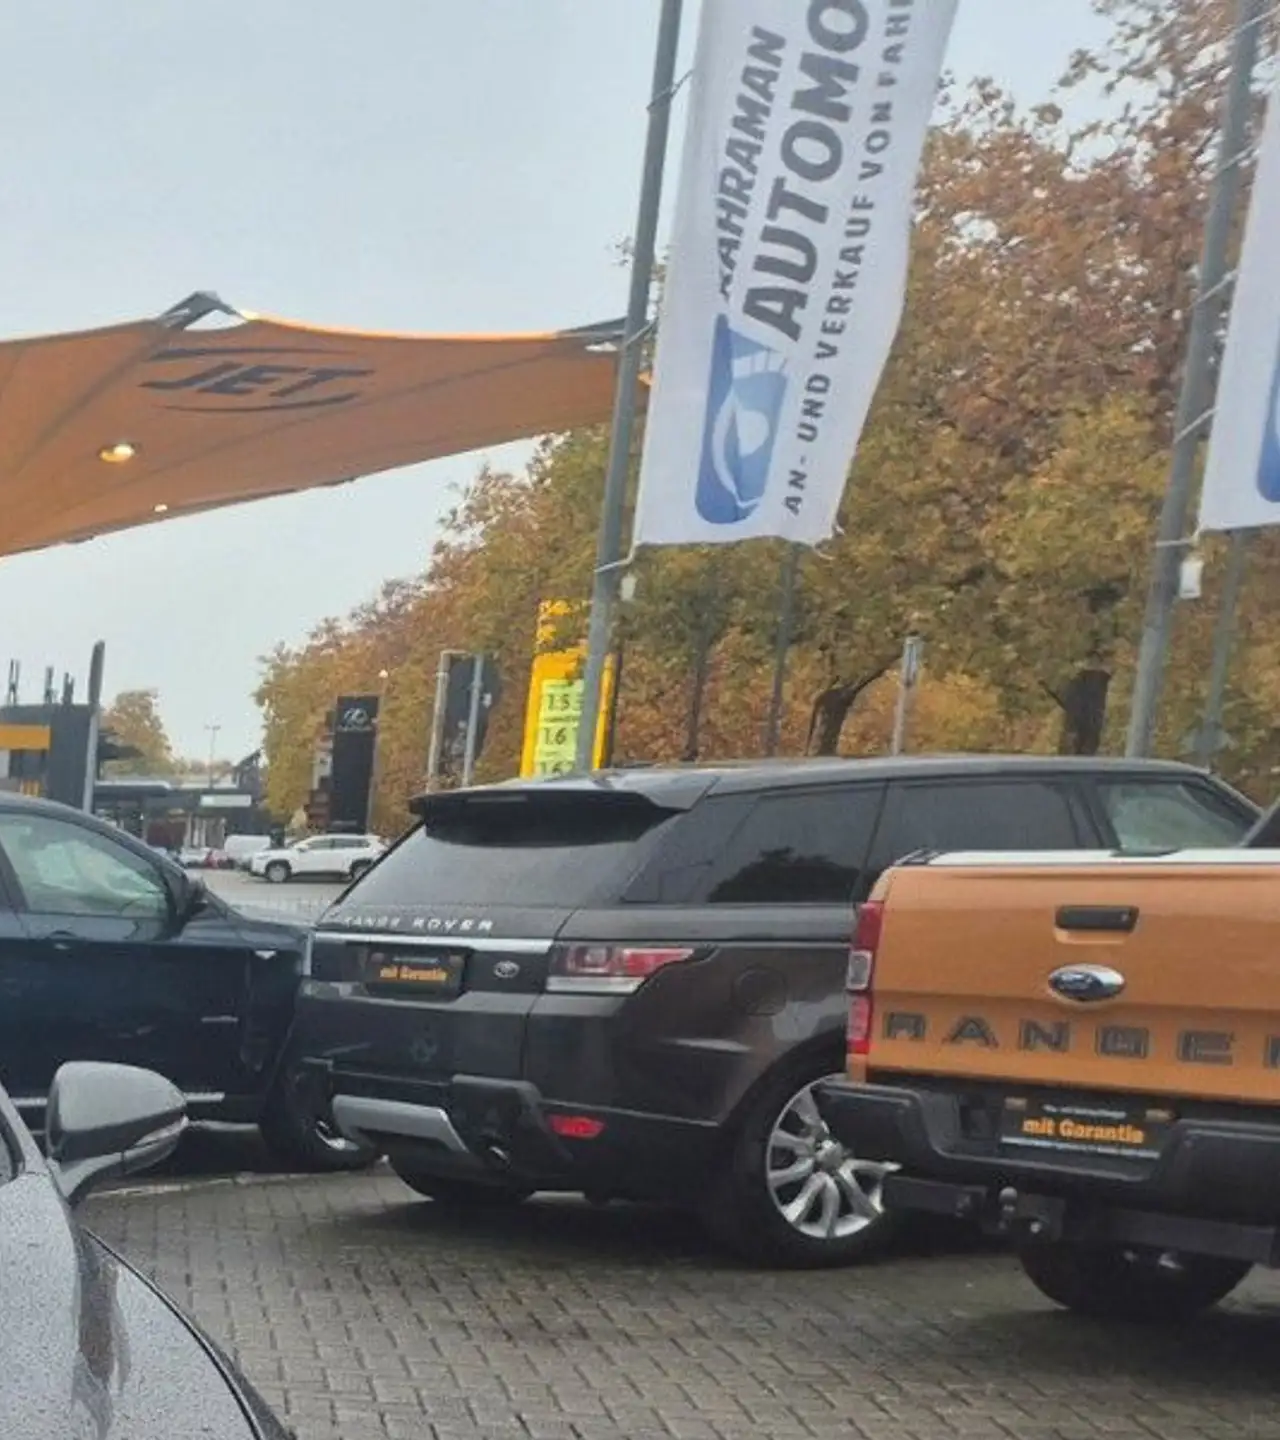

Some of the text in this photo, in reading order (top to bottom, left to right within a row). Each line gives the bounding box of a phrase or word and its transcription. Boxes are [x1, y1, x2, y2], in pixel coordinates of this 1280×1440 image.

[742, 0, 870, 342] AUTOMO
[797, 374, 831, 442] UND
[814, 196, 875, 361] VERKAUF
[858, 102, 892, 181] VON
[138, 361, 376, 398] JET
[412, 918, 494, 931] ROVER
[1023, 1117, 1145, 1144] mit Garantie
